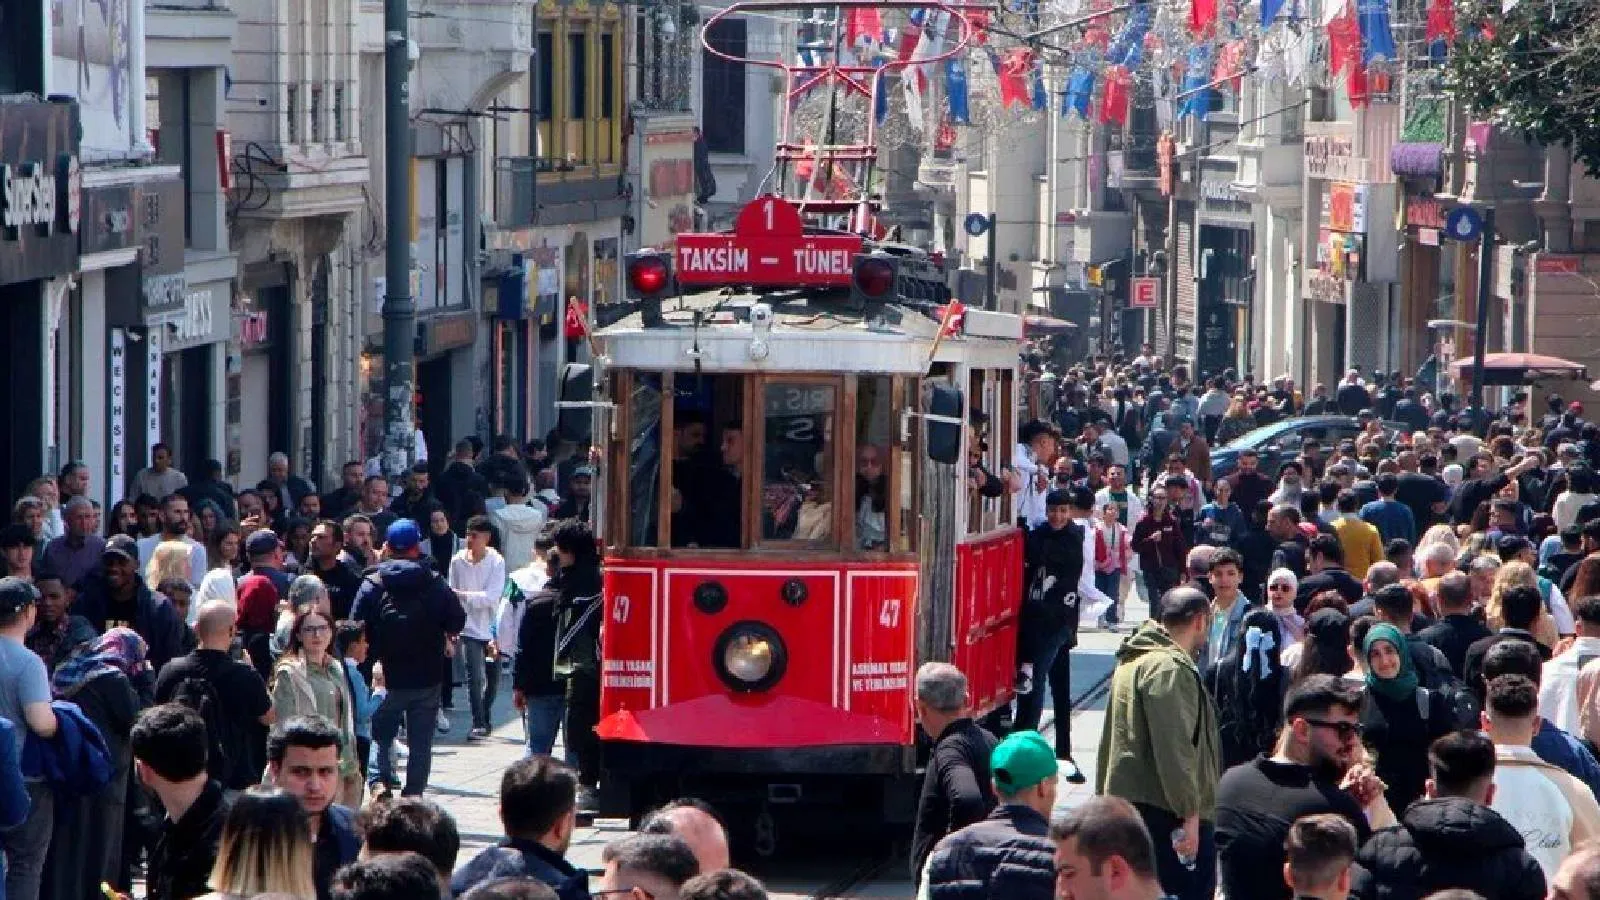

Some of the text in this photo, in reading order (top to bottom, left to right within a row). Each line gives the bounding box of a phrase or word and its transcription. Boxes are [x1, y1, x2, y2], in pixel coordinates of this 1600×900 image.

[763, 200, 774, 230] 1
[680, 241, 749, 273] TAKSİM
[794, 243, 853, 275] TÜNEL
[1139, 284, 1154, 300] E
[112, 347, 122, 476] WECHSEL
[613, 595, 629, 624] 47
[880, 599, 900, 628] 47
